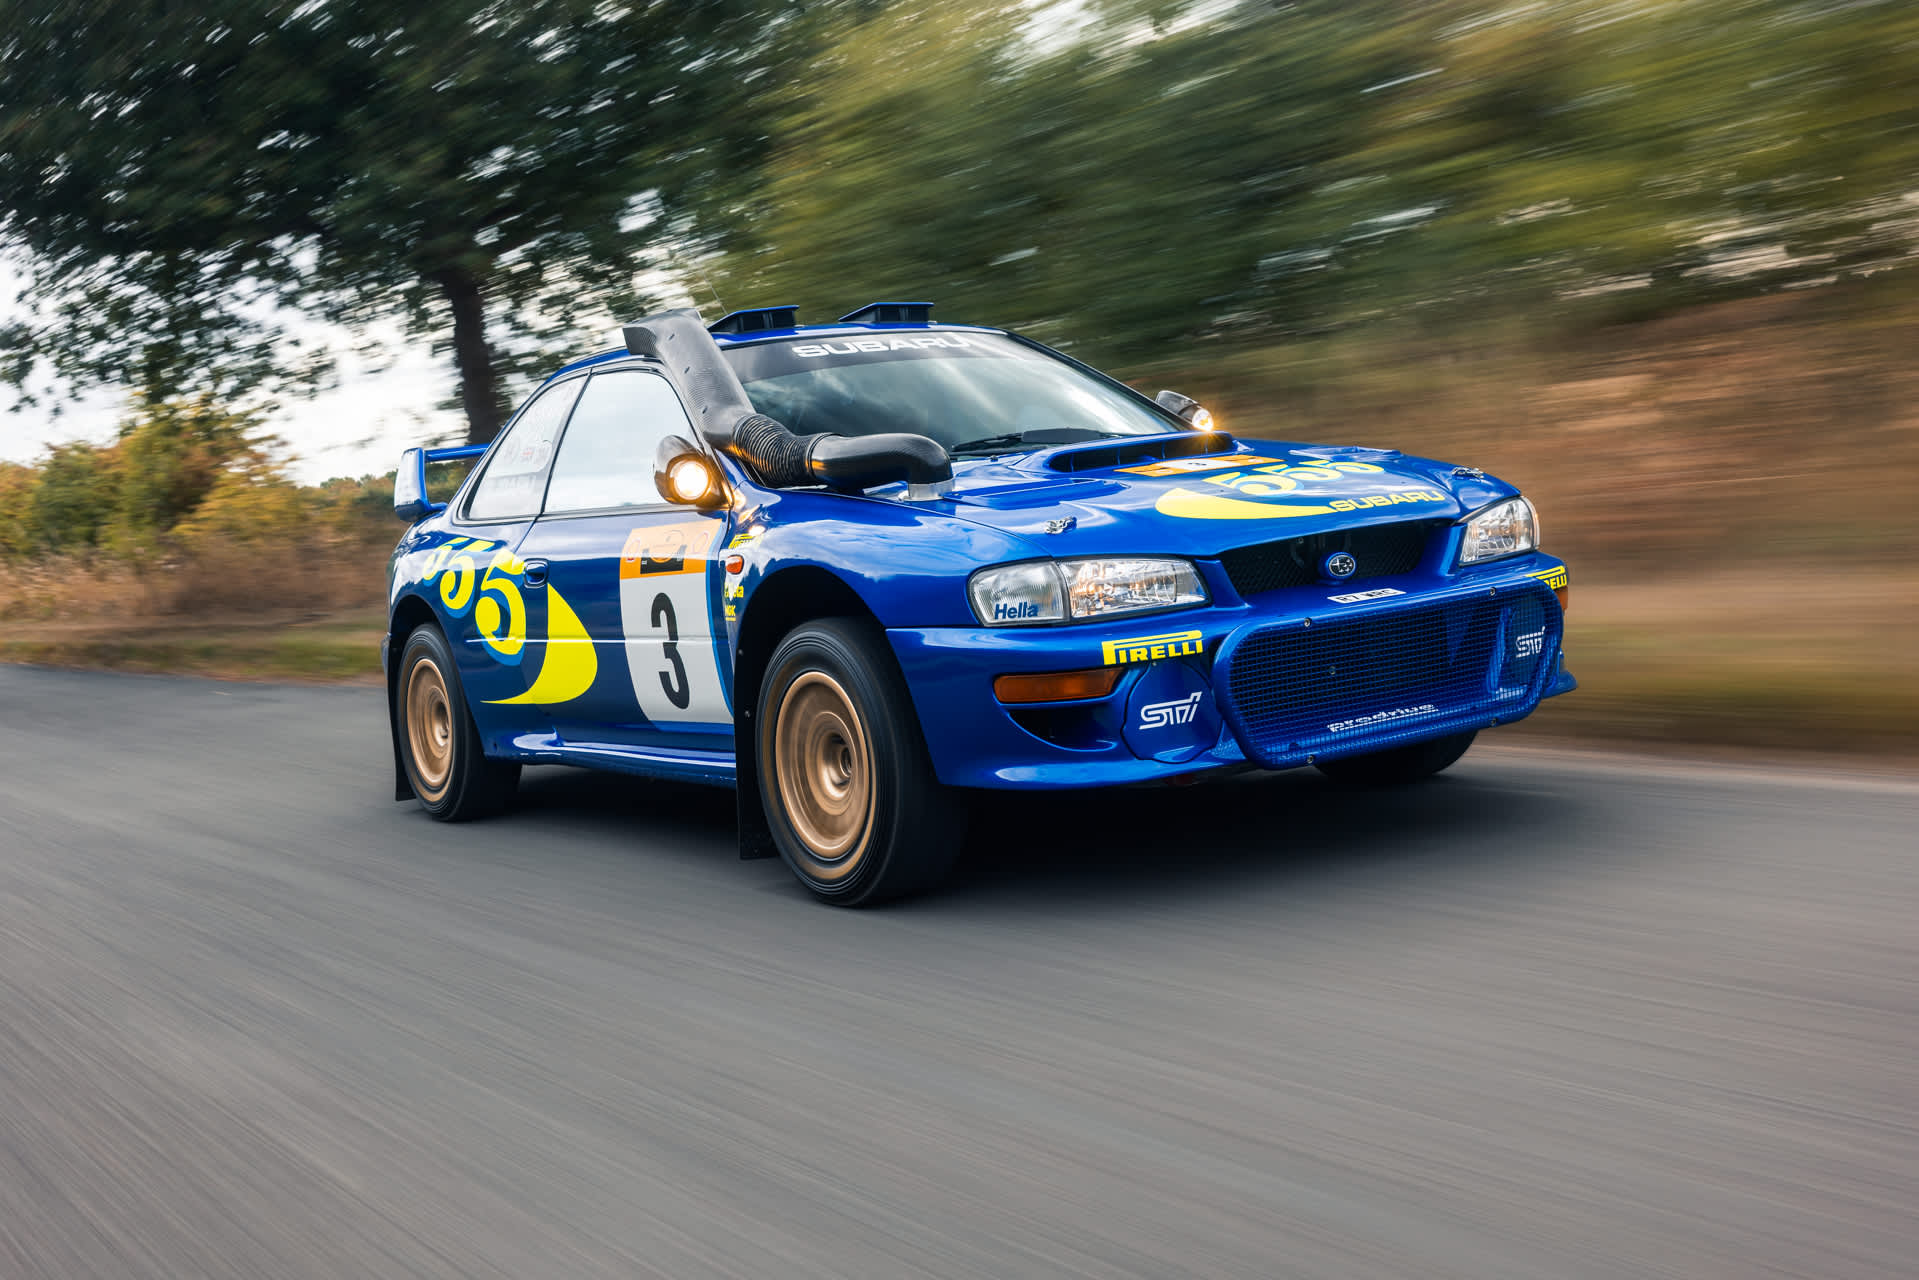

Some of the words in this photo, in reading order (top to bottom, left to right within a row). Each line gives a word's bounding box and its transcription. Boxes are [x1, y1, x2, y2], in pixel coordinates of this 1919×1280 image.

[792, 336, 970, 358] SUBARU
[1202, 459, 1386, 496] 555
[1328, 490, 1446, 512] SUBARU
[994, 602, 1039, 620] Hella
[650, 592, 690, 710] 3
[1101, 629, 1203, 665] PIRELLI
